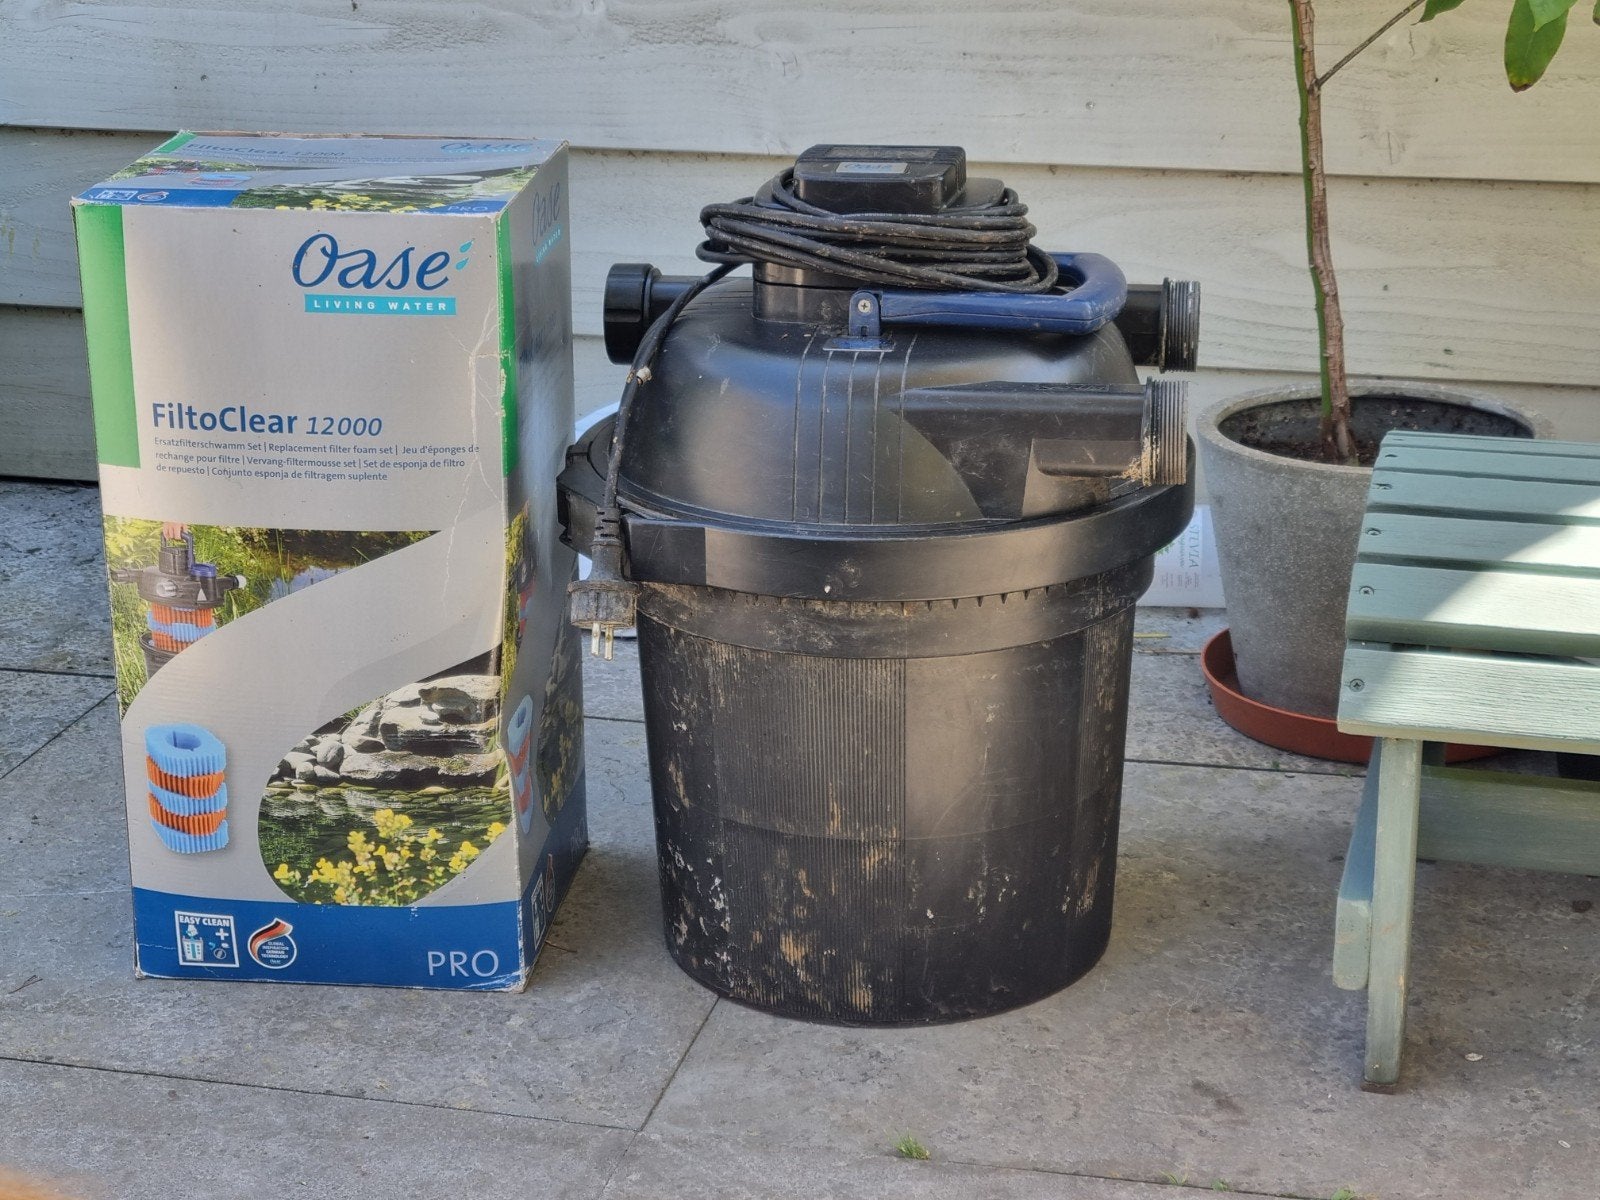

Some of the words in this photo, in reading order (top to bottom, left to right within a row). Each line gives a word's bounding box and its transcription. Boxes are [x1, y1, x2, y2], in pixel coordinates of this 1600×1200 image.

[292, 233, 450, 291] Oase
[313, 299, 376, 310] LIVING
[387, 301, 447, 311] WATER
[152, 402, 298, 434] FiltoClear
[305, 416, 383, 437] 12000
[154, 437, 246, 450] Ersatzfilterschwamm
[247, 442, 262, 451] Set
[268, 443, 327, 454] Replacement
[329, 444, 351, 454] filter
[353, 445, 377, 454] foam
[379, 446, 394, 454] set
[402, 446, 417, 454] Jeu
[420, 445, 466, 456] d'éponges
[155, 451, 194, 463] rechange
[196, 455, 216, 464] pour
[218, 454, 240, 464] filtre
[246, 456, 341, 468] Vervang-filtermousse
[343, 460, 357, 468] set
[363, 459, 378, 468] Set
[379, 459, 391, 468] de
[393, 460, 428, 470] esponja
[429, 459, 441, 468] de
[443, 458, 465, 467] filtro
[156, 464, 167, 472] de
[168, 465, 205, 476] repuesto
[211, 467, 253, 478] Conjunto
[254, 471, 289, 480] esponja
[291, 470, 302, 479] de
[304, 470, 346, 482] filtragem
[348, 471, 388, 482] suplente
[179, 915, 202, 925] EASY
[202, 917, 230, 927] CLEAN
[427, 950, 499, 977] PRO
